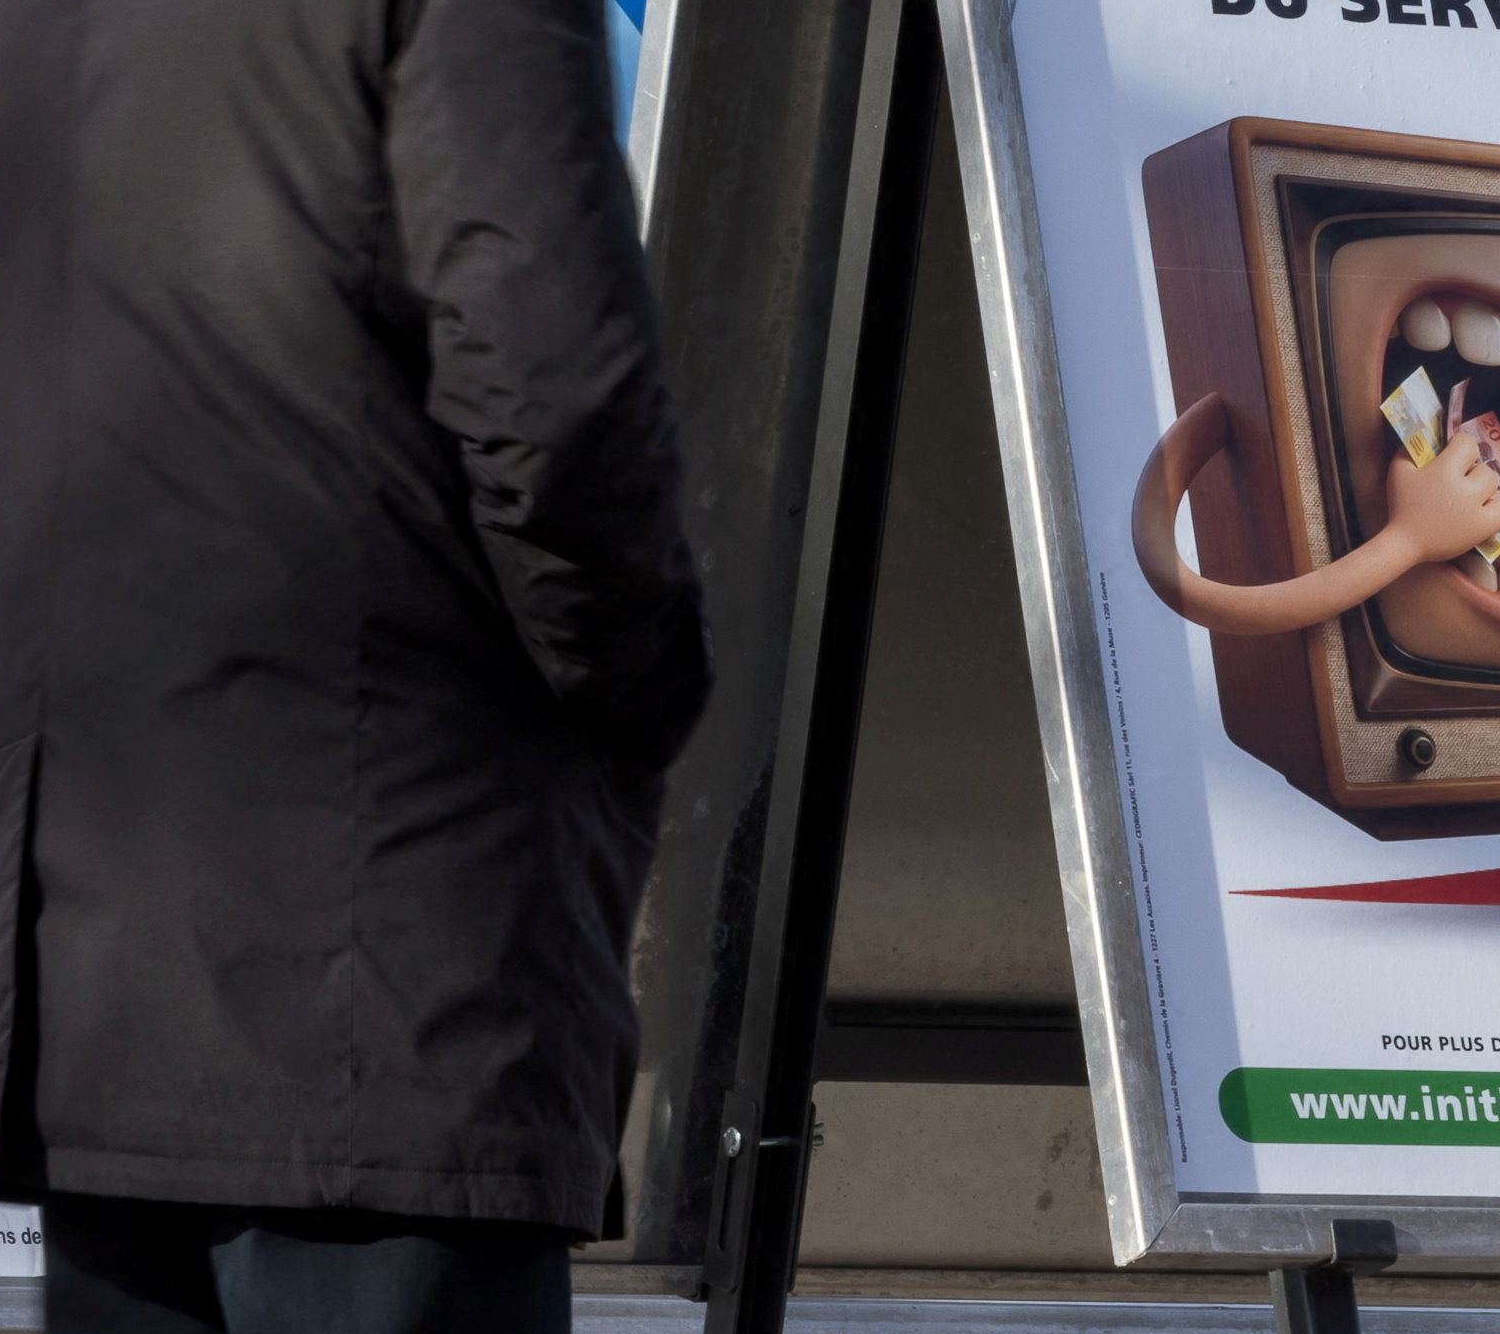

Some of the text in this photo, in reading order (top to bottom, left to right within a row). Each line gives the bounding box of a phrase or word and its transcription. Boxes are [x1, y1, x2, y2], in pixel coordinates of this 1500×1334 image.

[1482, 417, 1500, 442] 20
[1382, 1034, 1433, 1052] POUR
[1439, 1036, 1484, 1053] PLUS
[21, 1227, 43, 1246] de
